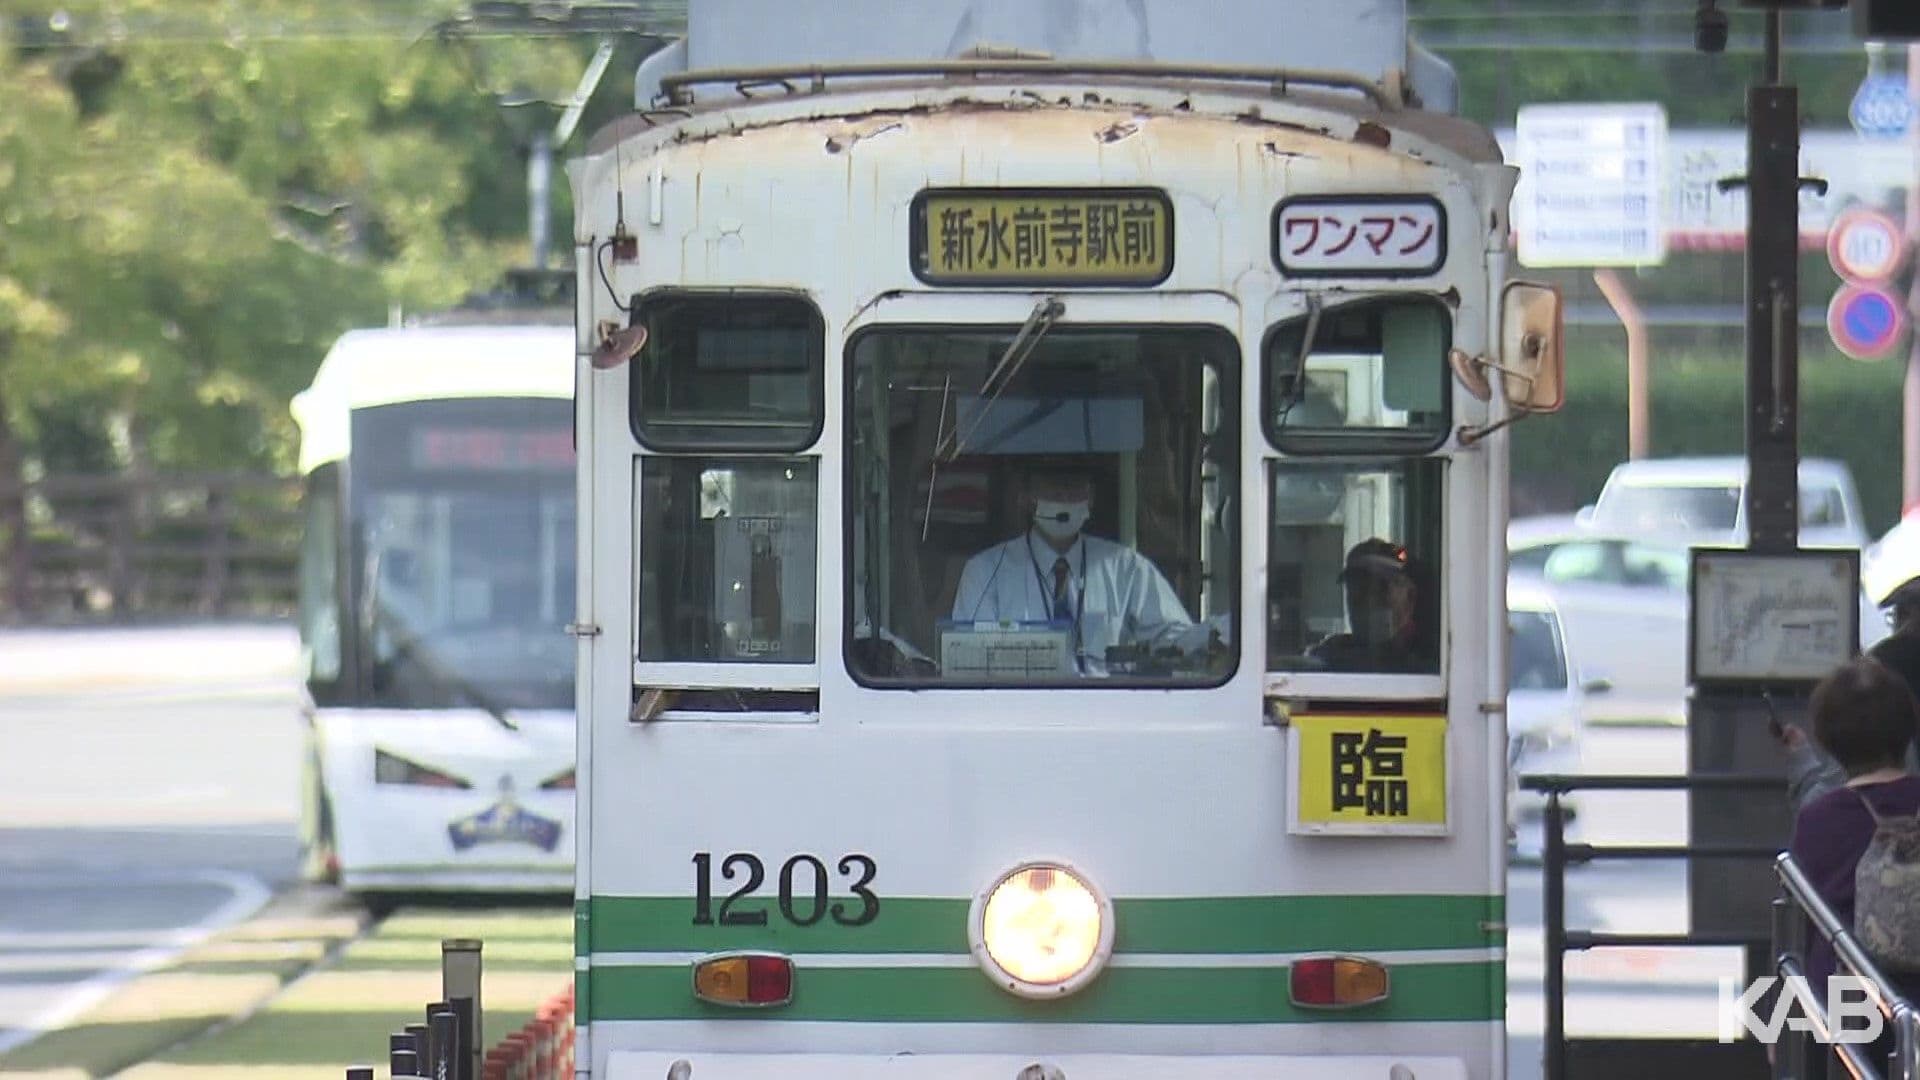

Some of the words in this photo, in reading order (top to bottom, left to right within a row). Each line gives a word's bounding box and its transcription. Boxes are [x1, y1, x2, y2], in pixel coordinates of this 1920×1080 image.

[940, 203, 1156, 271] 新水前寺駅前
[1286, 217, 1433, 255] ワンマン
[1331, 728, 1408, 816] 臨
[692, 852, 880, 927] 1203
